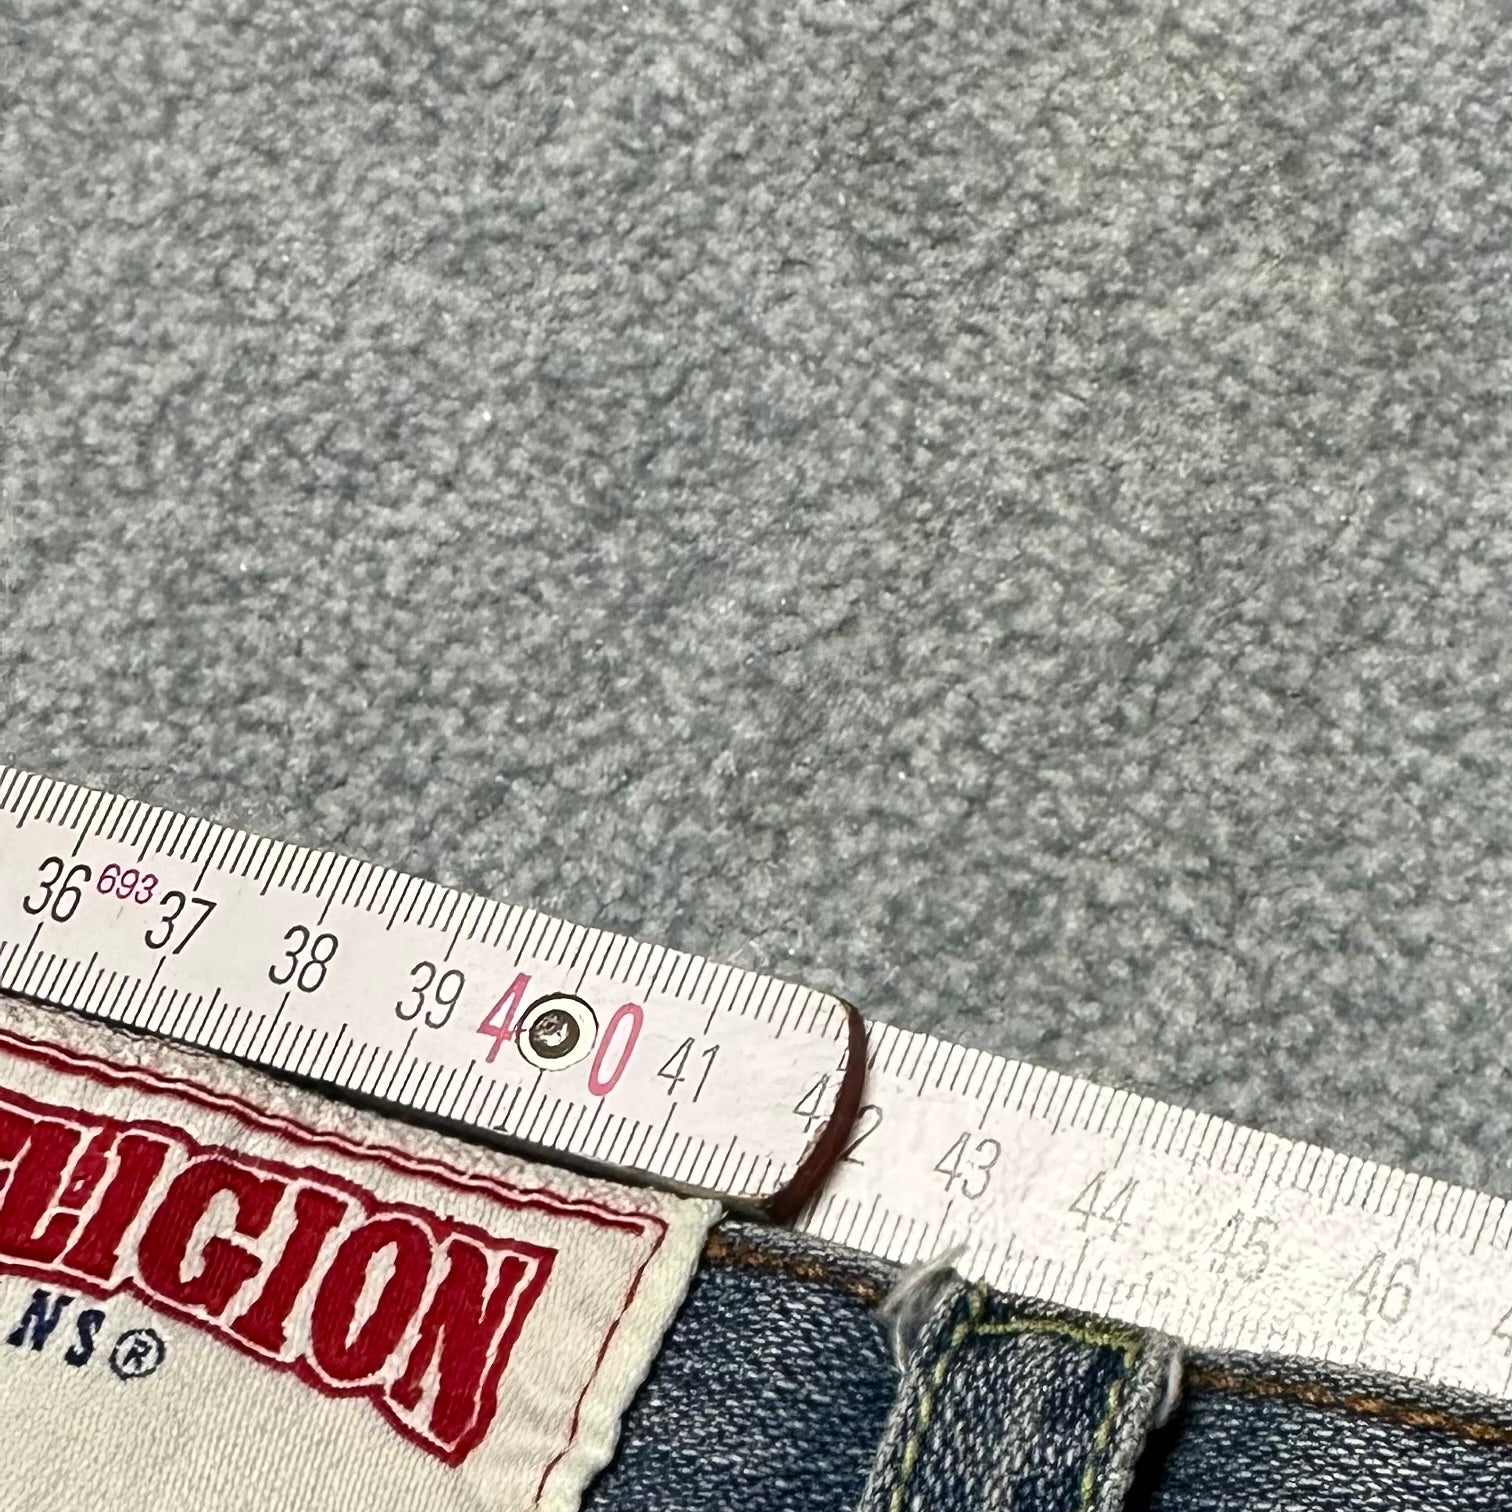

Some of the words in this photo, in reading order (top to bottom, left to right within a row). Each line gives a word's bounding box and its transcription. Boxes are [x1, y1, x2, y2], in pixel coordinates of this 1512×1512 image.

[97, 863, 158, 904] 693
[23, 856, 92, 922] 36
[144, 890, 217, 955] 37
[268, 925, 338, 993] 38
[395, 960, 465, 1029] 39
[476, 972, 644, 1096] 40
[657, 1036, 721, 1102] 41
[934, 1131, 1001, 1200] 43
[1069, 1170, 1139, 1242] 44
[1207, 1209, 1279, 1282] 45
[1347, 1249, 1420, 1324] 46
[0, 1100, 548, 1455] LIGION
